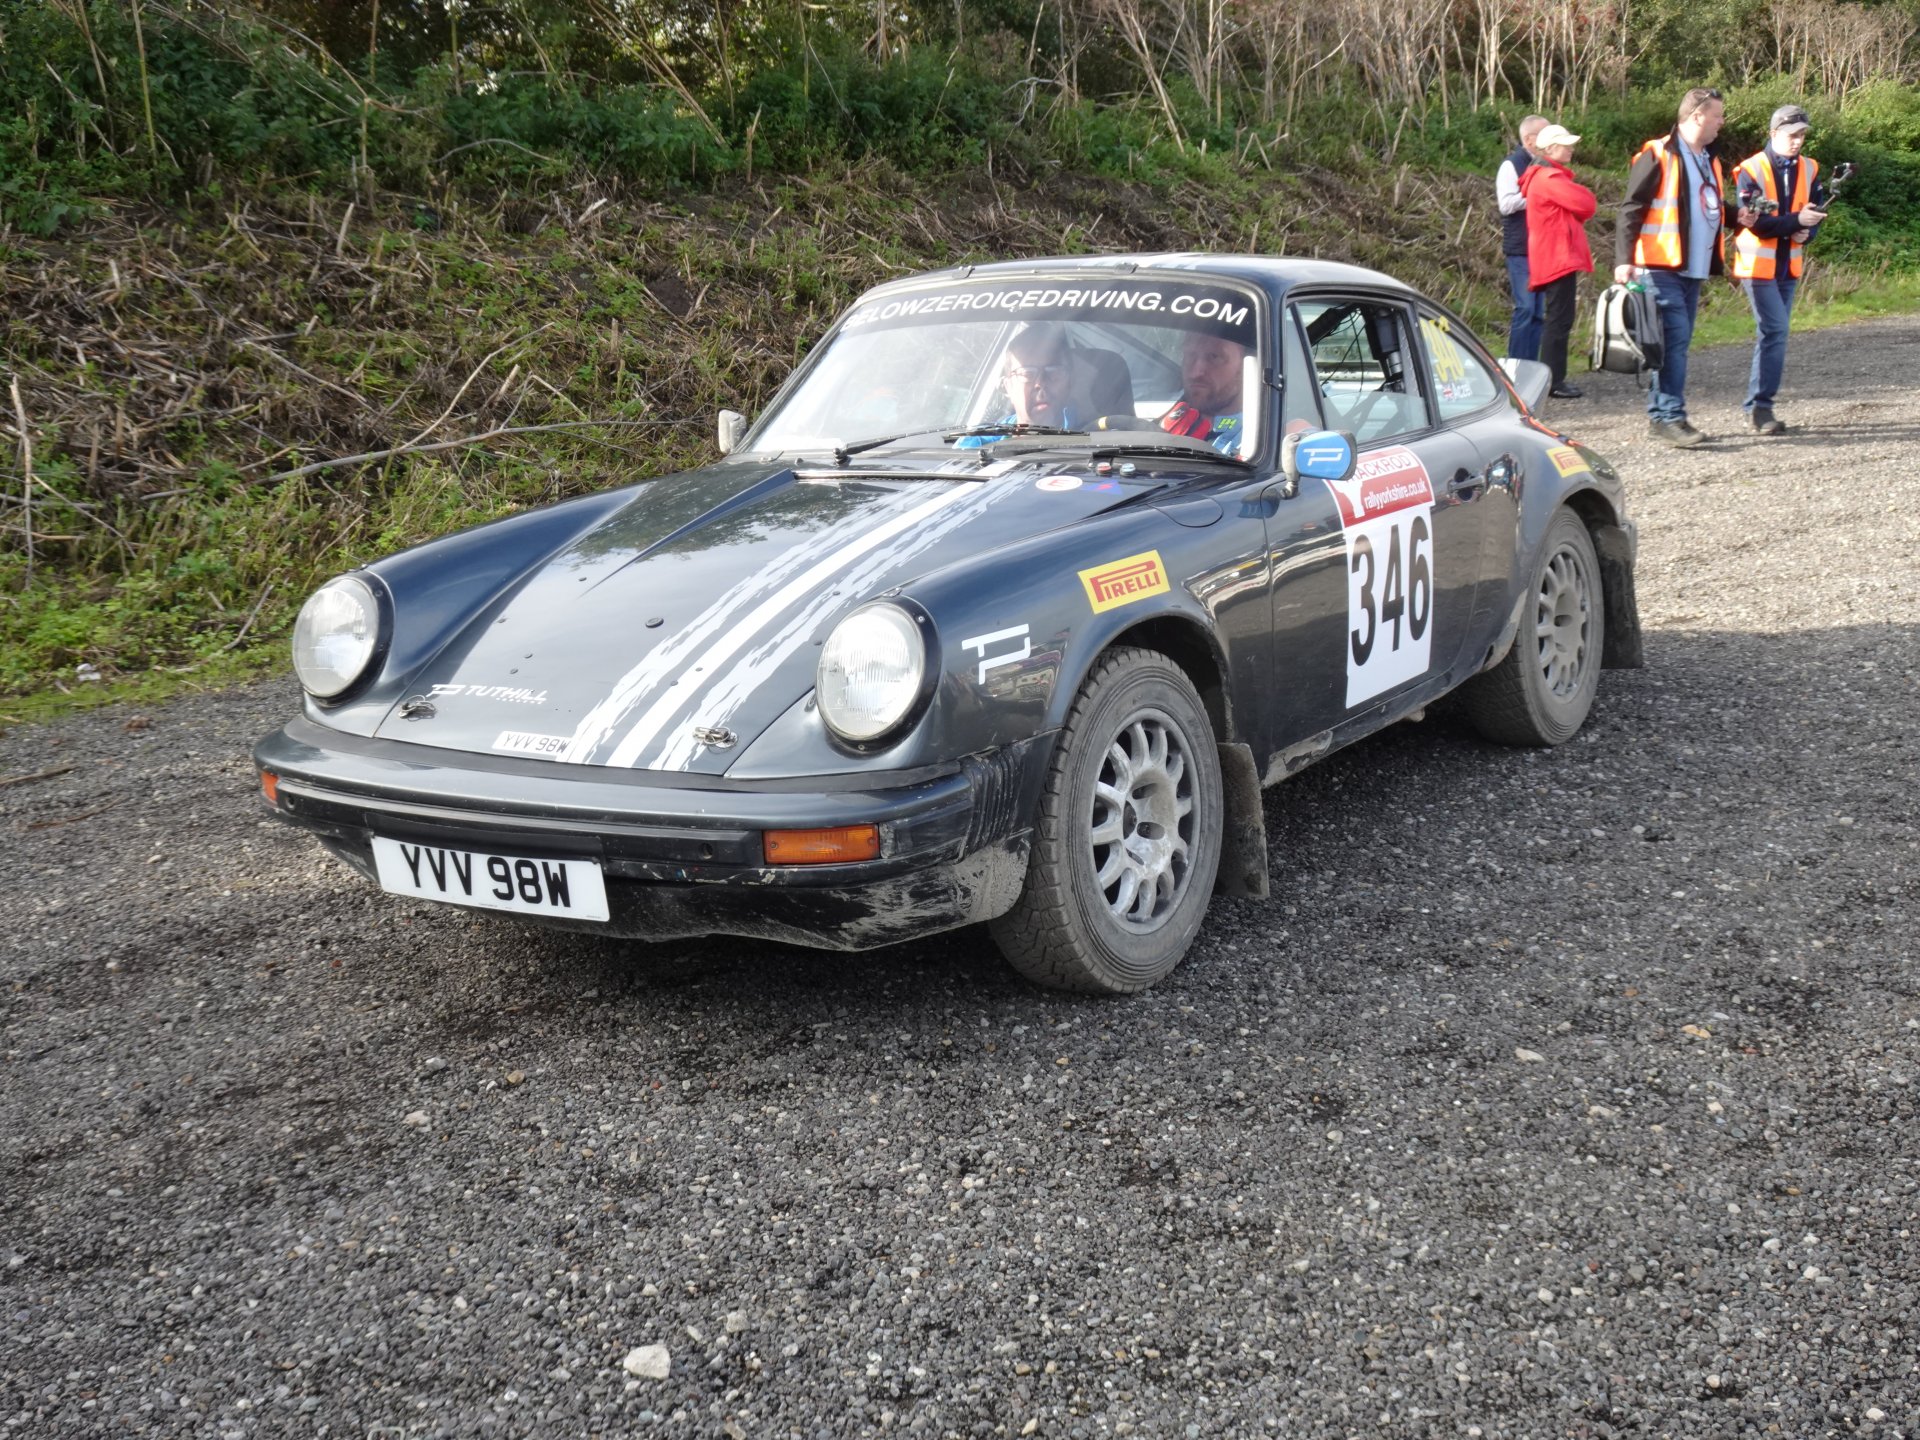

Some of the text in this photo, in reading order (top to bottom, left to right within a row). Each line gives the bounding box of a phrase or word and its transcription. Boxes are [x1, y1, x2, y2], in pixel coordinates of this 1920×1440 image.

[1346, 454, 1412, 483] ACKROD
[1364, 478, 1428, 510] rallyyorkshire.co.uk
[1089, 560, 1161, 603] PIRELLI
[1351, 515, 1430, 667] 346
[465, 685, 547, 702] TUTHILL
[504, 733, 571, 754] YVV 98W
[400, 843, 571, 908] YVV 98W
